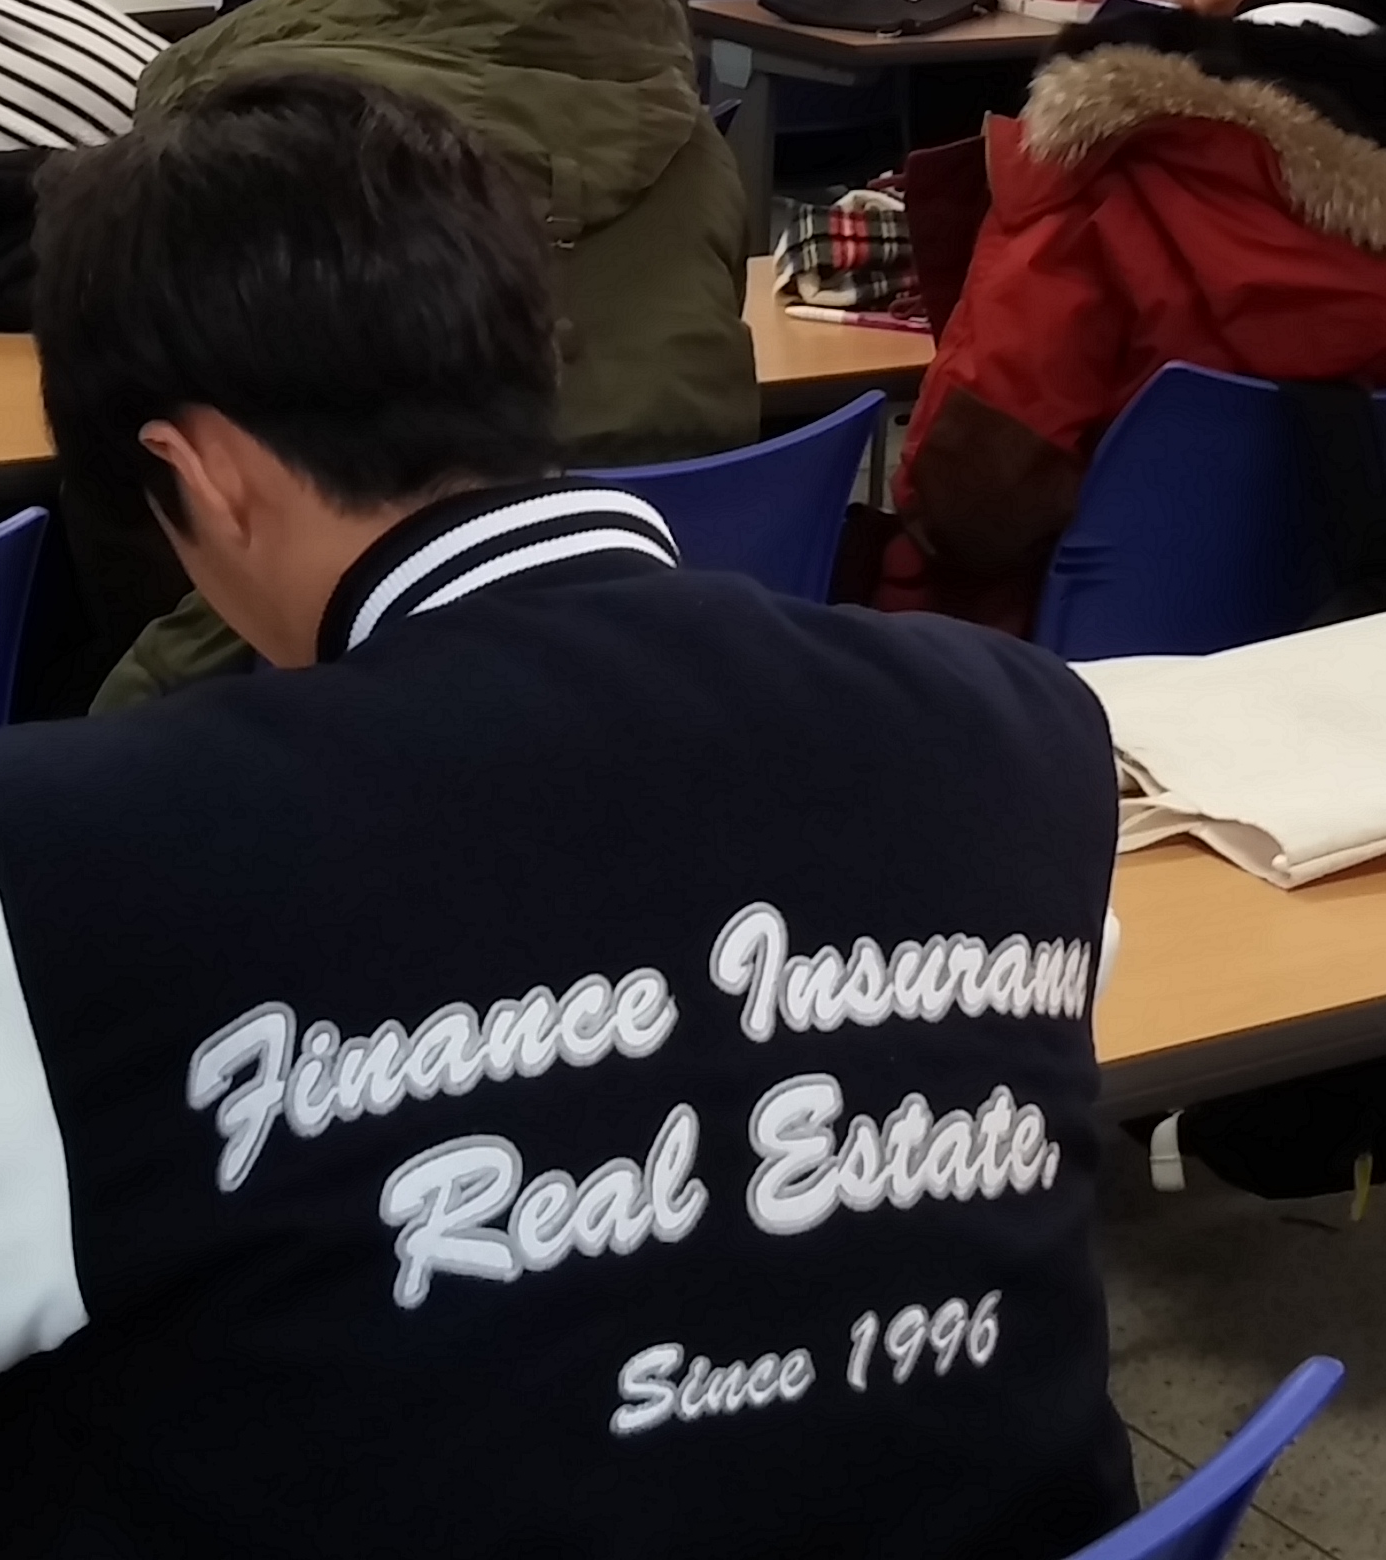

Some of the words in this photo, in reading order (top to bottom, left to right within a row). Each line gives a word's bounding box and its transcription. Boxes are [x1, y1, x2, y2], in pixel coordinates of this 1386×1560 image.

[187, 967, 679, 1192] Finance
[380, 1102, 708, 1309] Real
[609, 1342, 816, 1435] Since
[846, 1289, 1002, 1392] 1996
